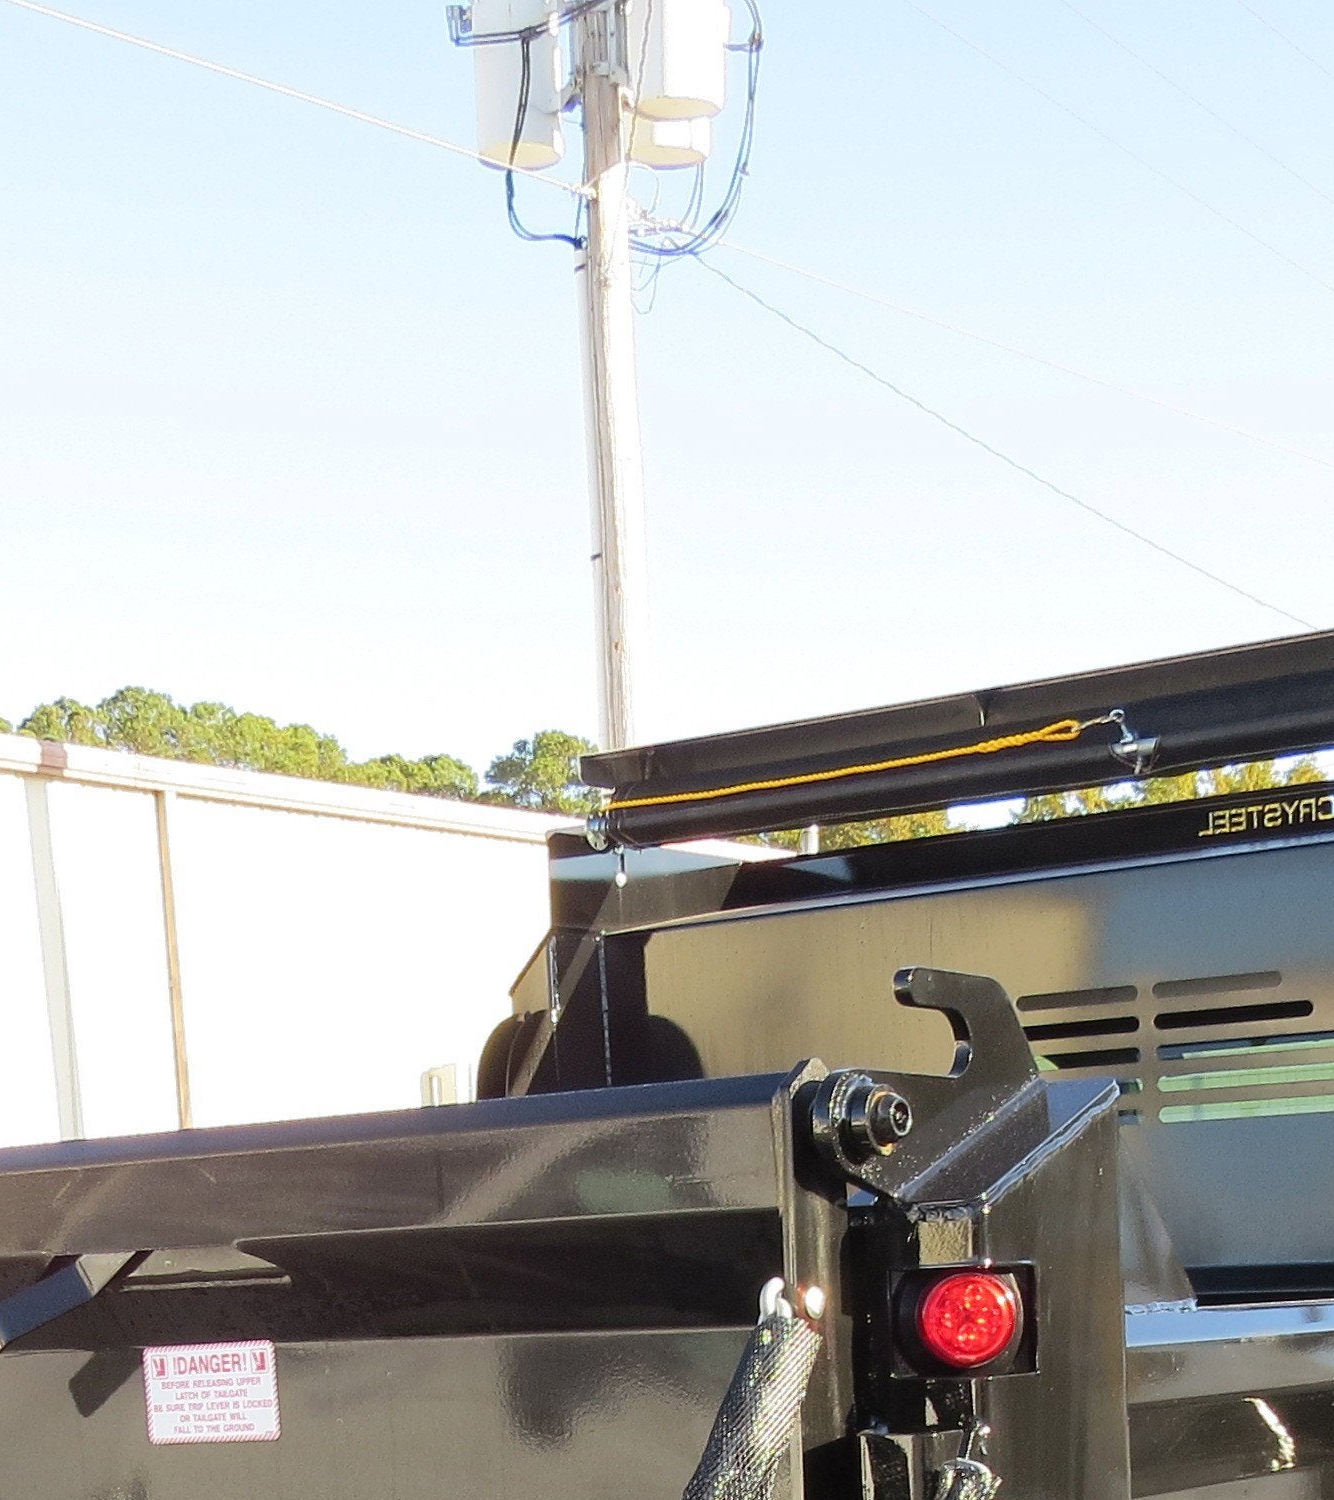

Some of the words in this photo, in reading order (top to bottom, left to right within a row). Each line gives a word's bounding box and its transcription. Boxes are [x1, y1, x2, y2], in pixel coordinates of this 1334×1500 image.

[161, 1381, 190, 1390] BEFORE
[193, 1378, 234, 1388] RELEASING
[236, 1377, 261, 1386] UPPER
[175, 1391, 199, 1400] LATCH
[201, 1391, 211, 1399] OF
[214, 1389, 248, 1398] TAILGATE
[154, 1404, 163, 1413] BE
[166, 1404, 185, 1412] SURE
[206, 1402, 230, 1410] LEVER
[232, 1401, 240, 1409] IS
[243, 1399, 273, 1409] LOCKED
[180, 1414, 190, 1422] OR
[193, 1413, 226, 1422] TAILGATE
[229, 1412, 247, 1420] WILL
[174, 1425, 191, 1434] FALL
[194, 1425, 204, 1433] TO
[207, 1424, 220, 1433] THE
[223, 1423, 255, 1432] GROUND
